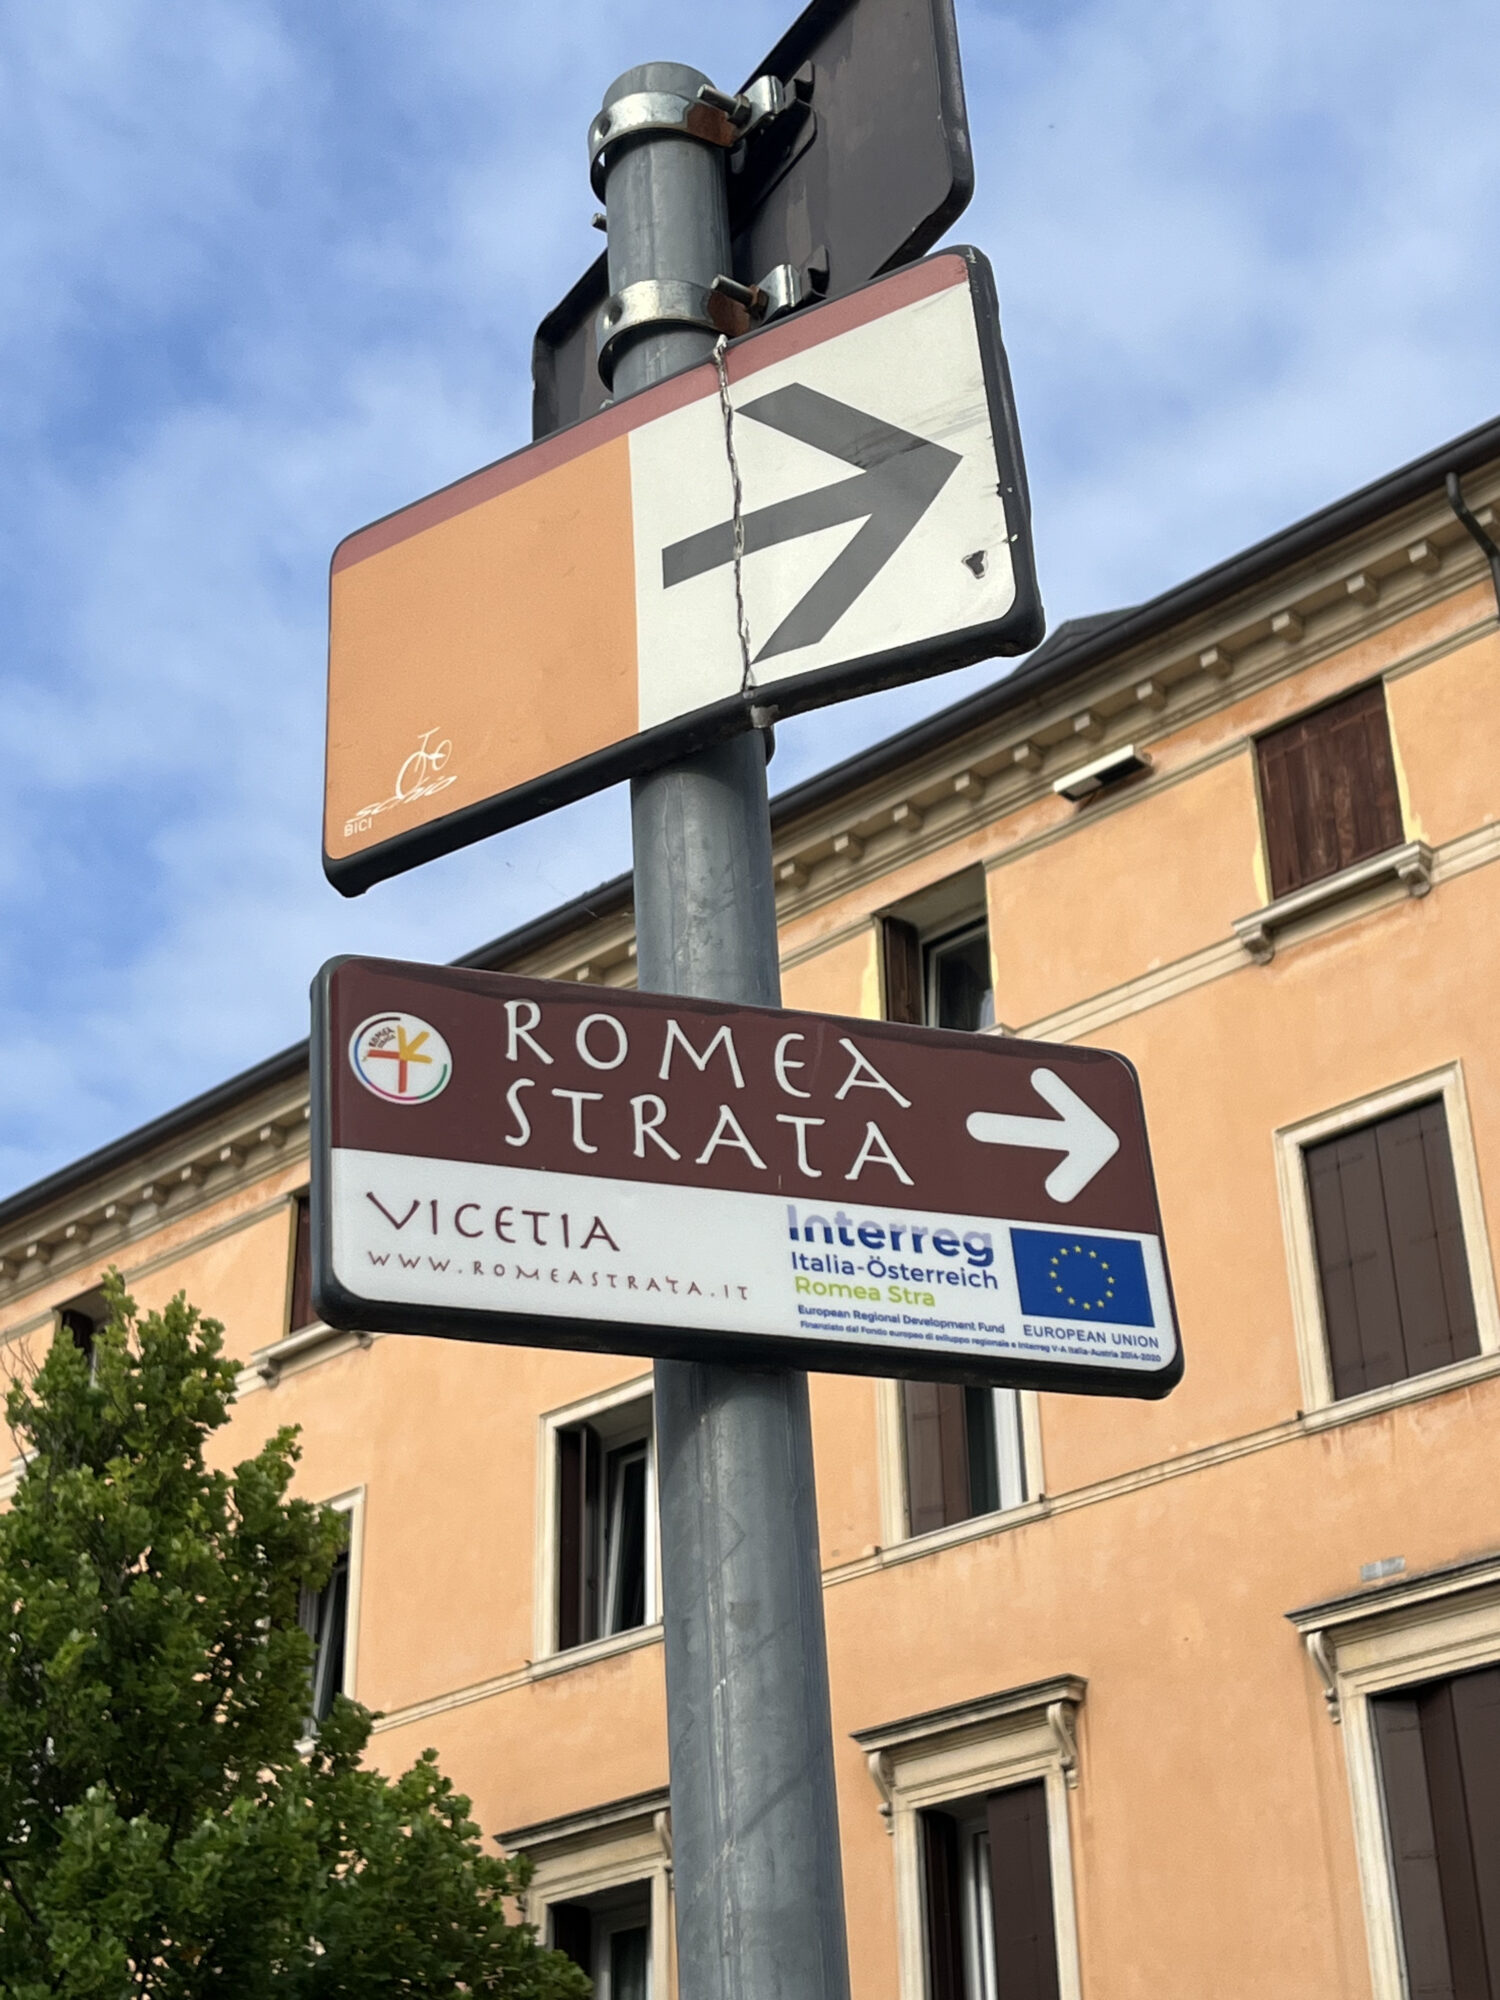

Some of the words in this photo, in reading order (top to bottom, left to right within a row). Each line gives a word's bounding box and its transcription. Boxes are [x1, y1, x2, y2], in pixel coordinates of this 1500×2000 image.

[344, 817, 373, 838] BICI
[503, 998, 913, 1109] ROMEA
[504, 1077, 915, 1187] STRATA
[366, 1191, 621, 1252] VICETIA
[786, 1204, 994, 1268] Interreg
[368, 1250, 749, 1301] WWW.ROMEASTRATA.IT
[791, 1251, 999, 1290] Italia-Österreich
[794, 1276, 882, 1302] Romea
[887, 1285, 936, 1308] Stra
[797, 1304, 851, 1318] European
[852, 1310, 901, 1324] Regional
[902, 1314, 977, 1331] Development
[977, 1321, 1006, 1334] Fund
[1023, 1324, 1107, 1344] EUROPEAN
[1111, 1333, 1160, 1349] UNION
[1018, 1341, 1050, 1353] Interreg
